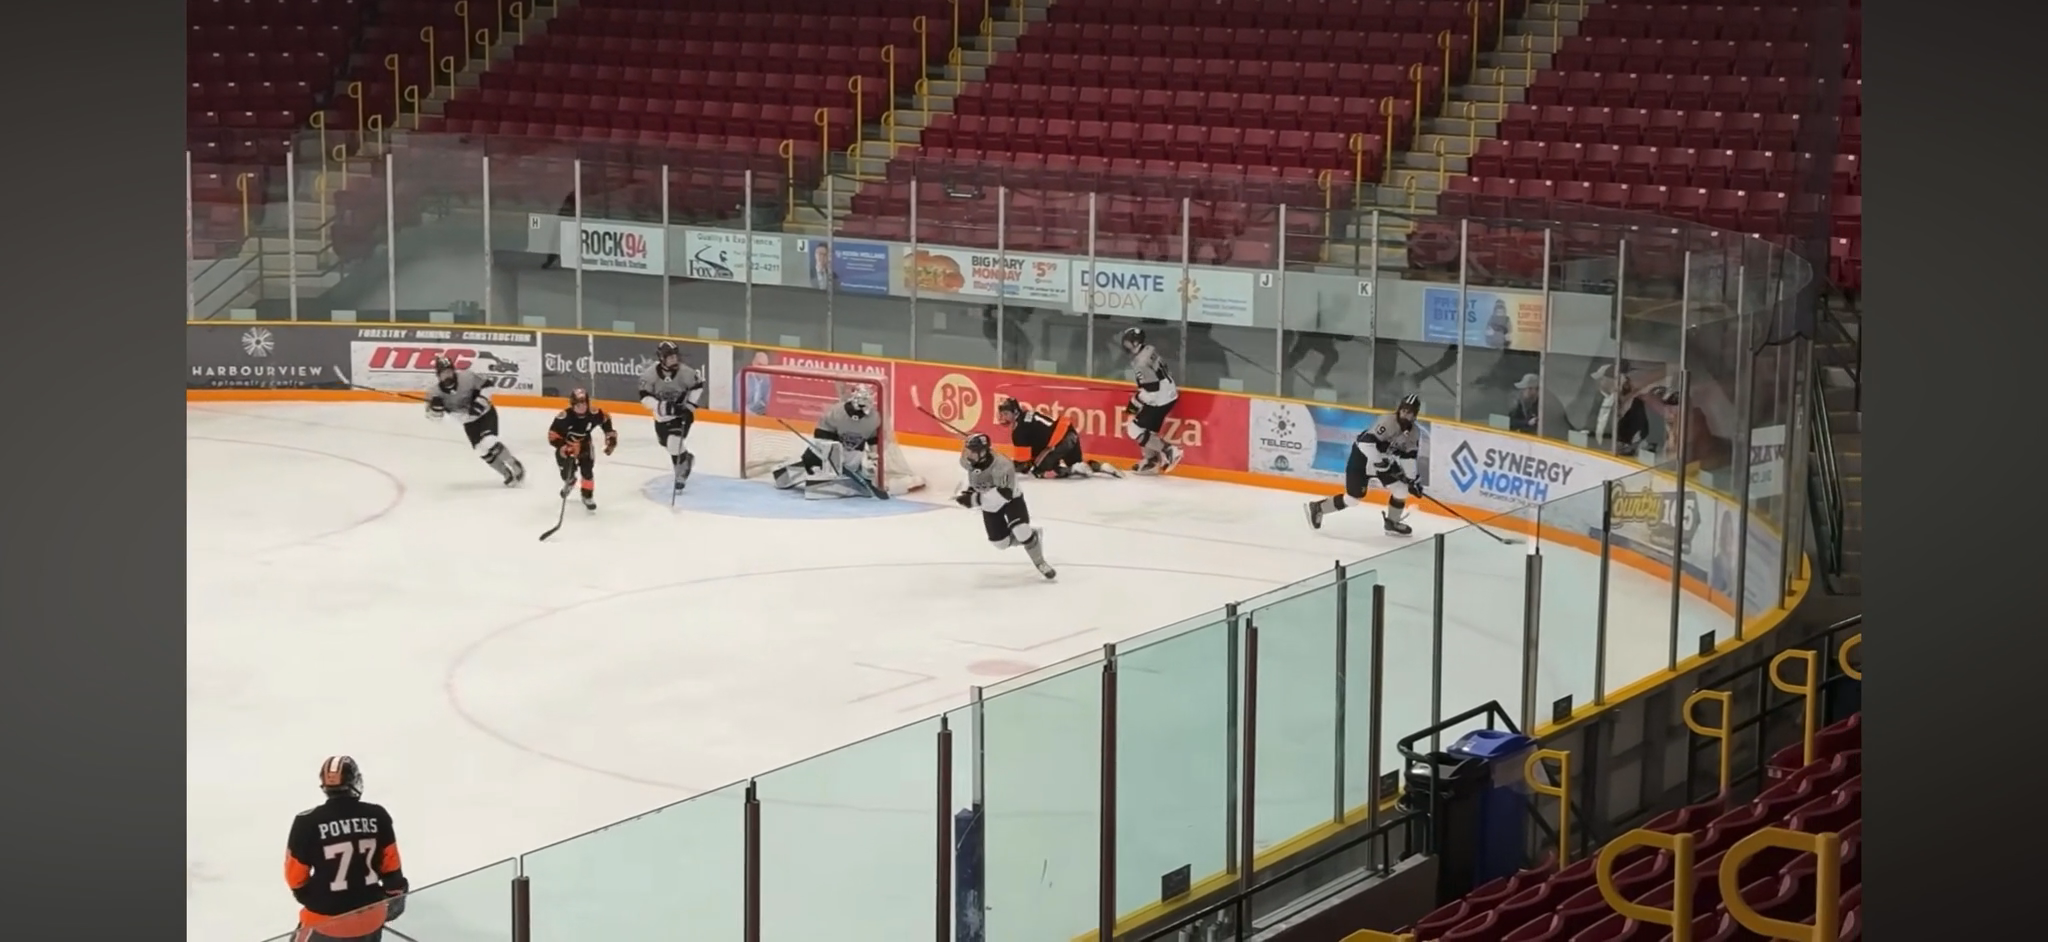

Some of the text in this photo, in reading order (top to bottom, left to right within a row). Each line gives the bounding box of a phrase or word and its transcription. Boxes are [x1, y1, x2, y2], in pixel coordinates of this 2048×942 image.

[532, 217, 539, 228] H
[581, 229, 647, 259] ROCK94
[799, 240, 805, 251] J
[749, 262, 780, 272] 22-4211
[971, 255, 1025, 270] BIG MARY
[1080, 270, 1164, 292] DONATE
[1262, 274, 1270, 287] J
[1360, 283, 1369, 295] K
[1080, 289, 1149, 311] TODAY
[1434, 297, 1477, 310] FRT
[1434, 308, 1477, 323] BITS
[358, 329, 532, 342] FORESTRY MINING CONSTRUCTION
[368, 346, 476, 371] ITEC
[545, 352, 644, 377] The Chronicle
[191, 365, 323, 377] HARBOURVIEW
[938, 382, 978, 423] BP
[1114, 405, 1203, 447] Pza
[1260, 437, 1303, 450] TELECO
[1482, 447, 1573, 486] SYNERGY
[1480, 469, 1549, 503] NORTH
[318, 817, 378, 839] POWERS
[322, 838, 379, 891] 77
